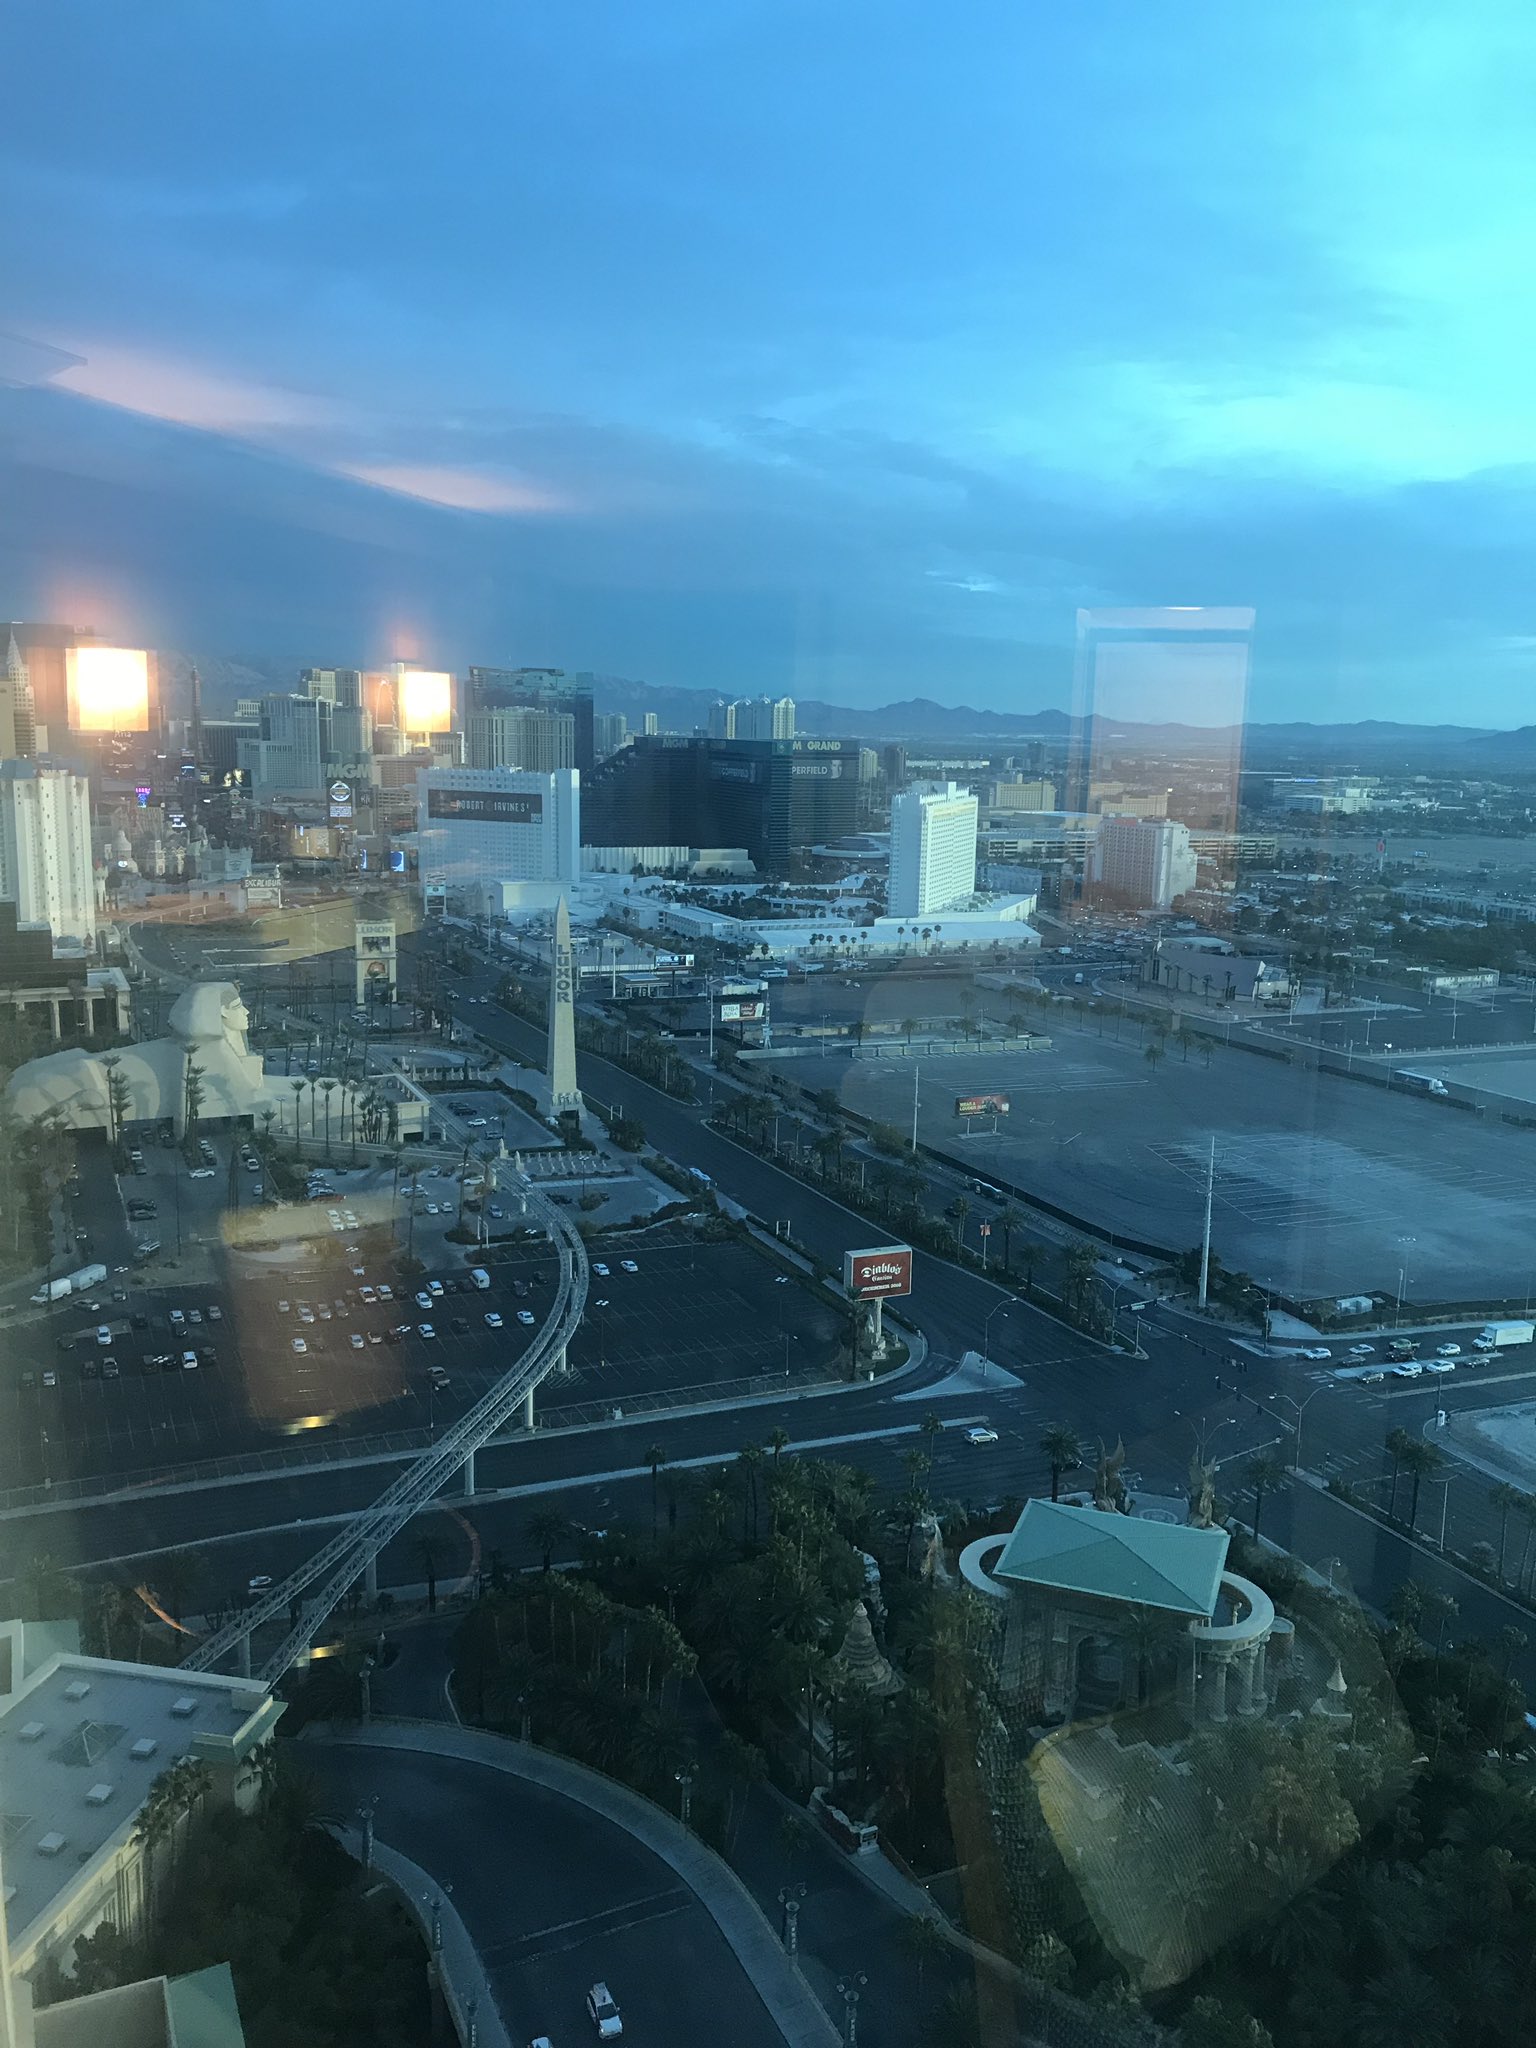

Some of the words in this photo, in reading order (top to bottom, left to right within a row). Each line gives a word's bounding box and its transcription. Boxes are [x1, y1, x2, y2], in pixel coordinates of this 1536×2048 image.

[807, 740, 841, 751] GRAND
[327, 763, 372, 779] MGM
[792, 766, 828, 775] PERFIELD
[557, 944, 571, 1003] LUXOR
[860, 1262, 903, 1278] Diablo's
